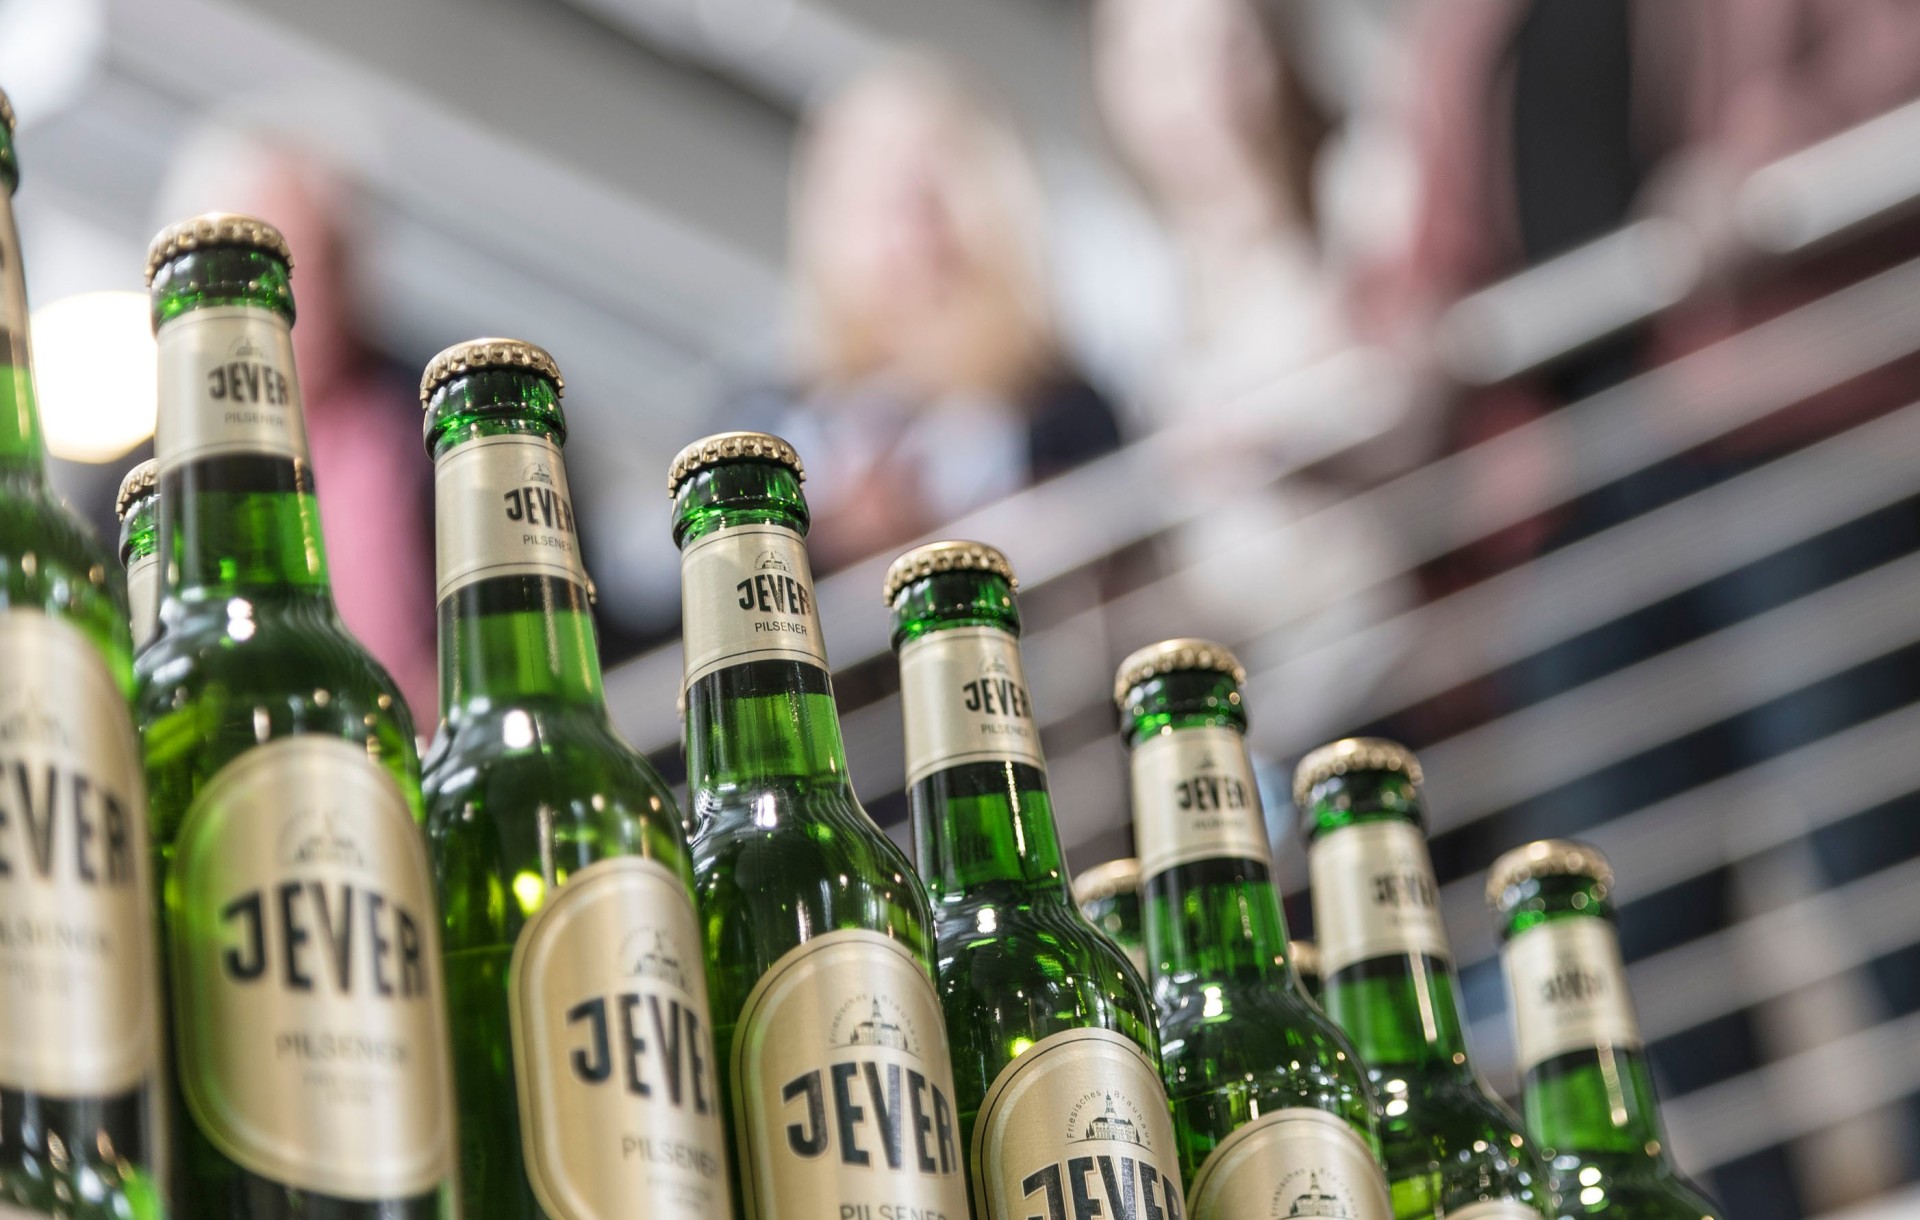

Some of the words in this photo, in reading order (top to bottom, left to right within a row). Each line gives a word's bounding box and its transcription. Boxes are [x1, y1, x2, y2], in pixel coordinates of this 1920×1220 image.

[207, 361, 289, 406] JEVER
[522, 534, 572, 552] PILSENER
[736, 573, 811, 616] JEVER
[754, 620, 808, 636] PILSENER
[221, 880, 431, 999] JEVER
[782, 1060, 958, 1176] JEVER
[1066, 1089, 1102, 1139] Friesisches
[1113, 1090, 1152, 1146] Brauhaus
